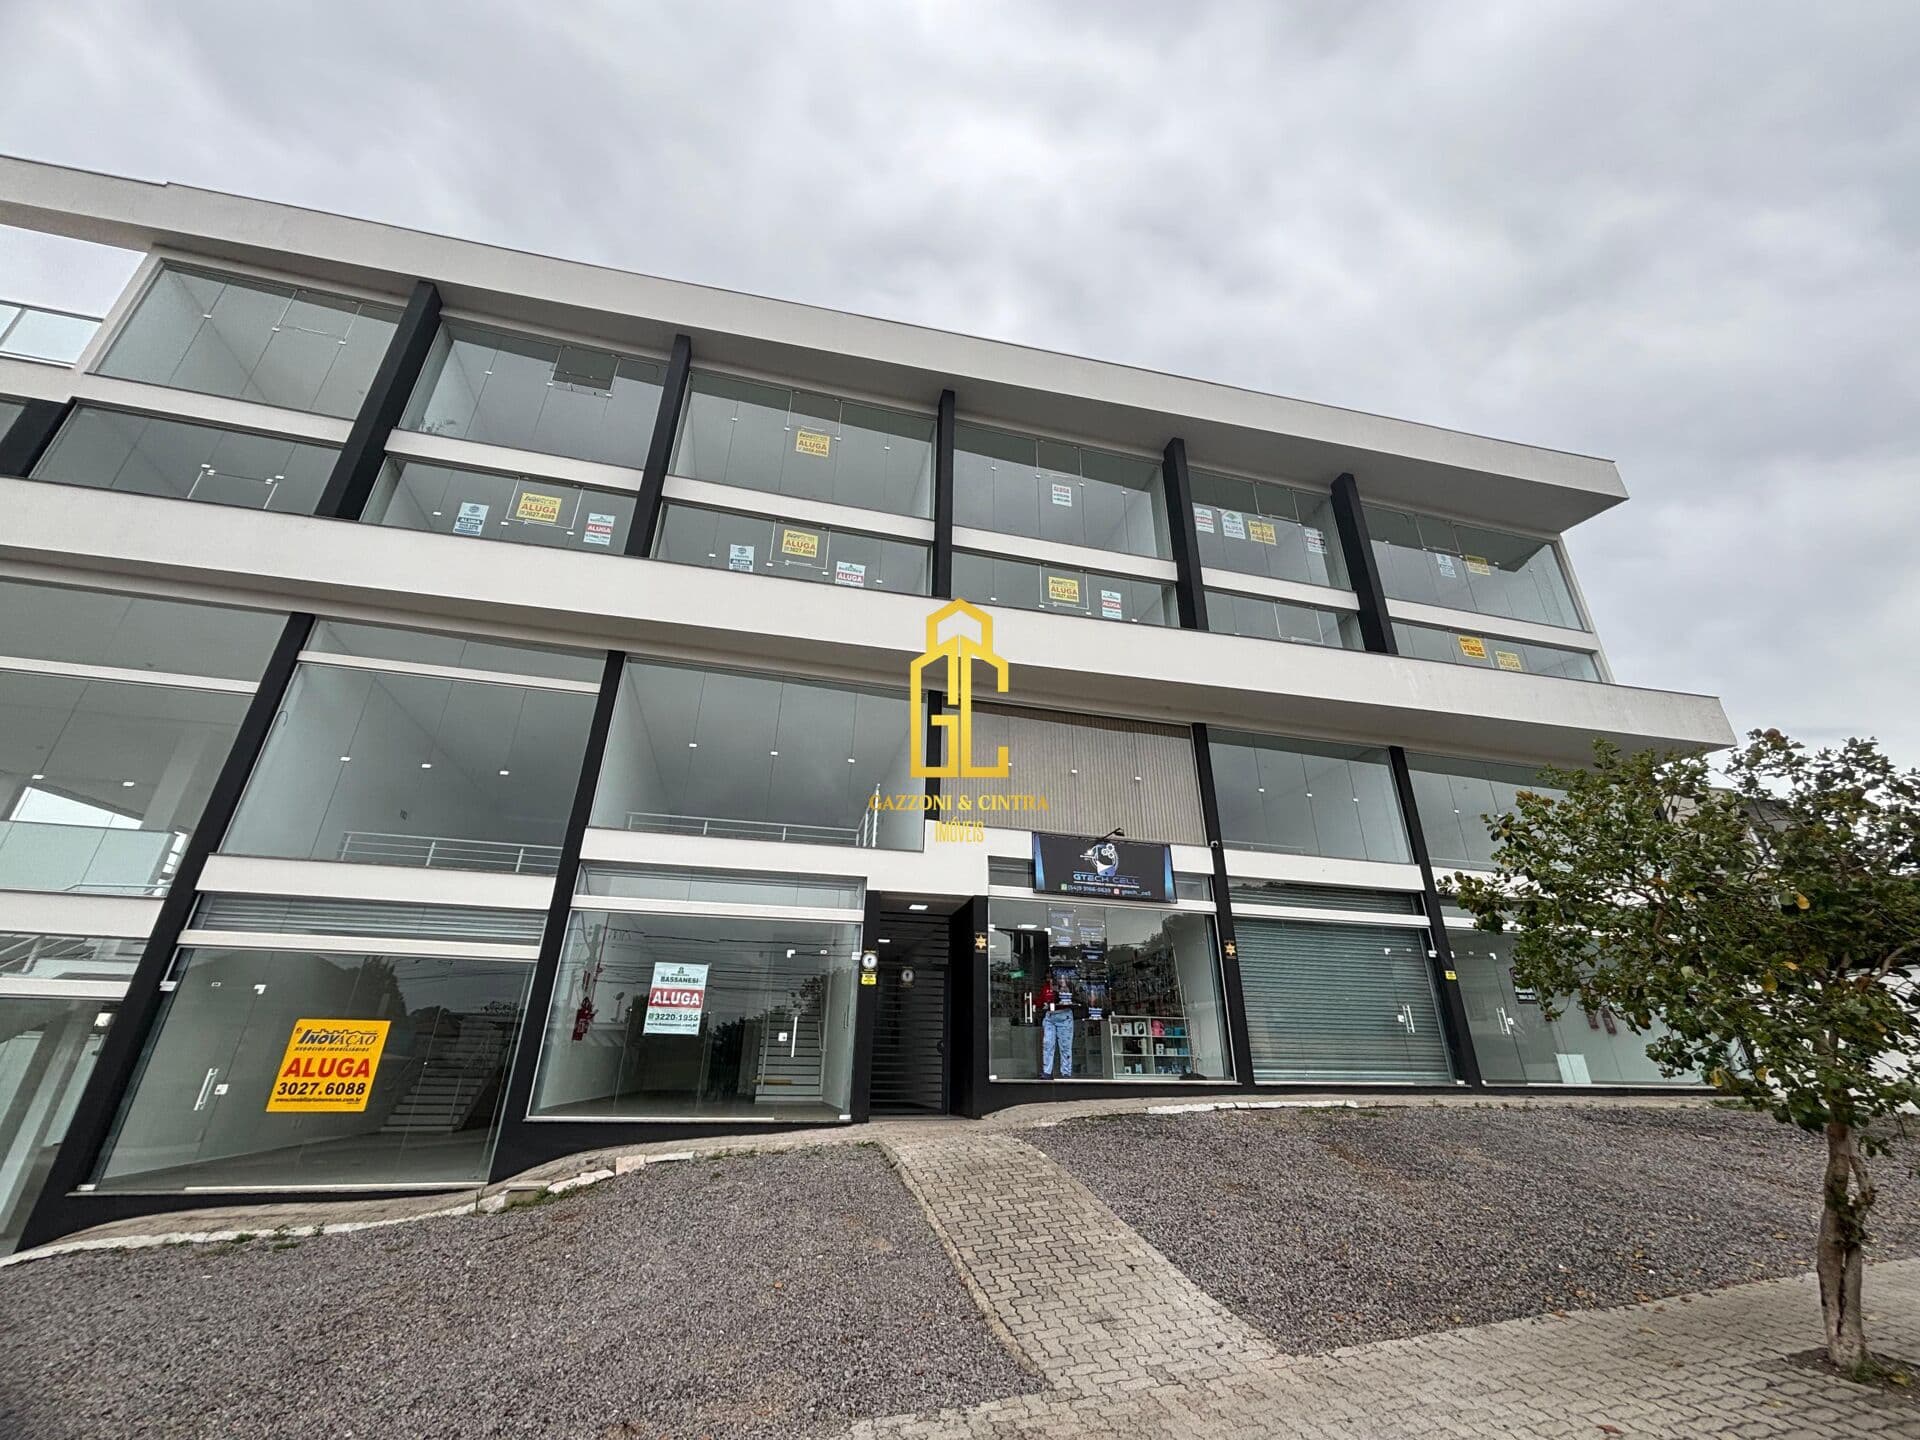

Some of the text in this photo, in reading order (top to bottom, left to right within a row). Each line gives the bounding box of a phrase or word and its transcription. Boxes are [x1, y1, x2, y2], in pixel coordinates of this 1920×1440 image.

[798, 440, 827, 450] ALUGA
[521, 503, 557, 515] ALUGA
[587, 524, 612, 533] ALUGA
[785, 540, 816, 550] ALUGA
[837, 572, 863, 582] ALUGA
[1050, 586, 1078, 596] ALUGA
[1072, 873, 1140, 885] GTECH CELL
[660, 976, 700, 984] BASSANESI
[651, 991, 701, 1006] ALUGA
[654, 1013, 699, 1022] 3220-1955
[282, 1057, 371, 1078] ALUGA
[277, 1082, 367, 1096] 3027.6088
